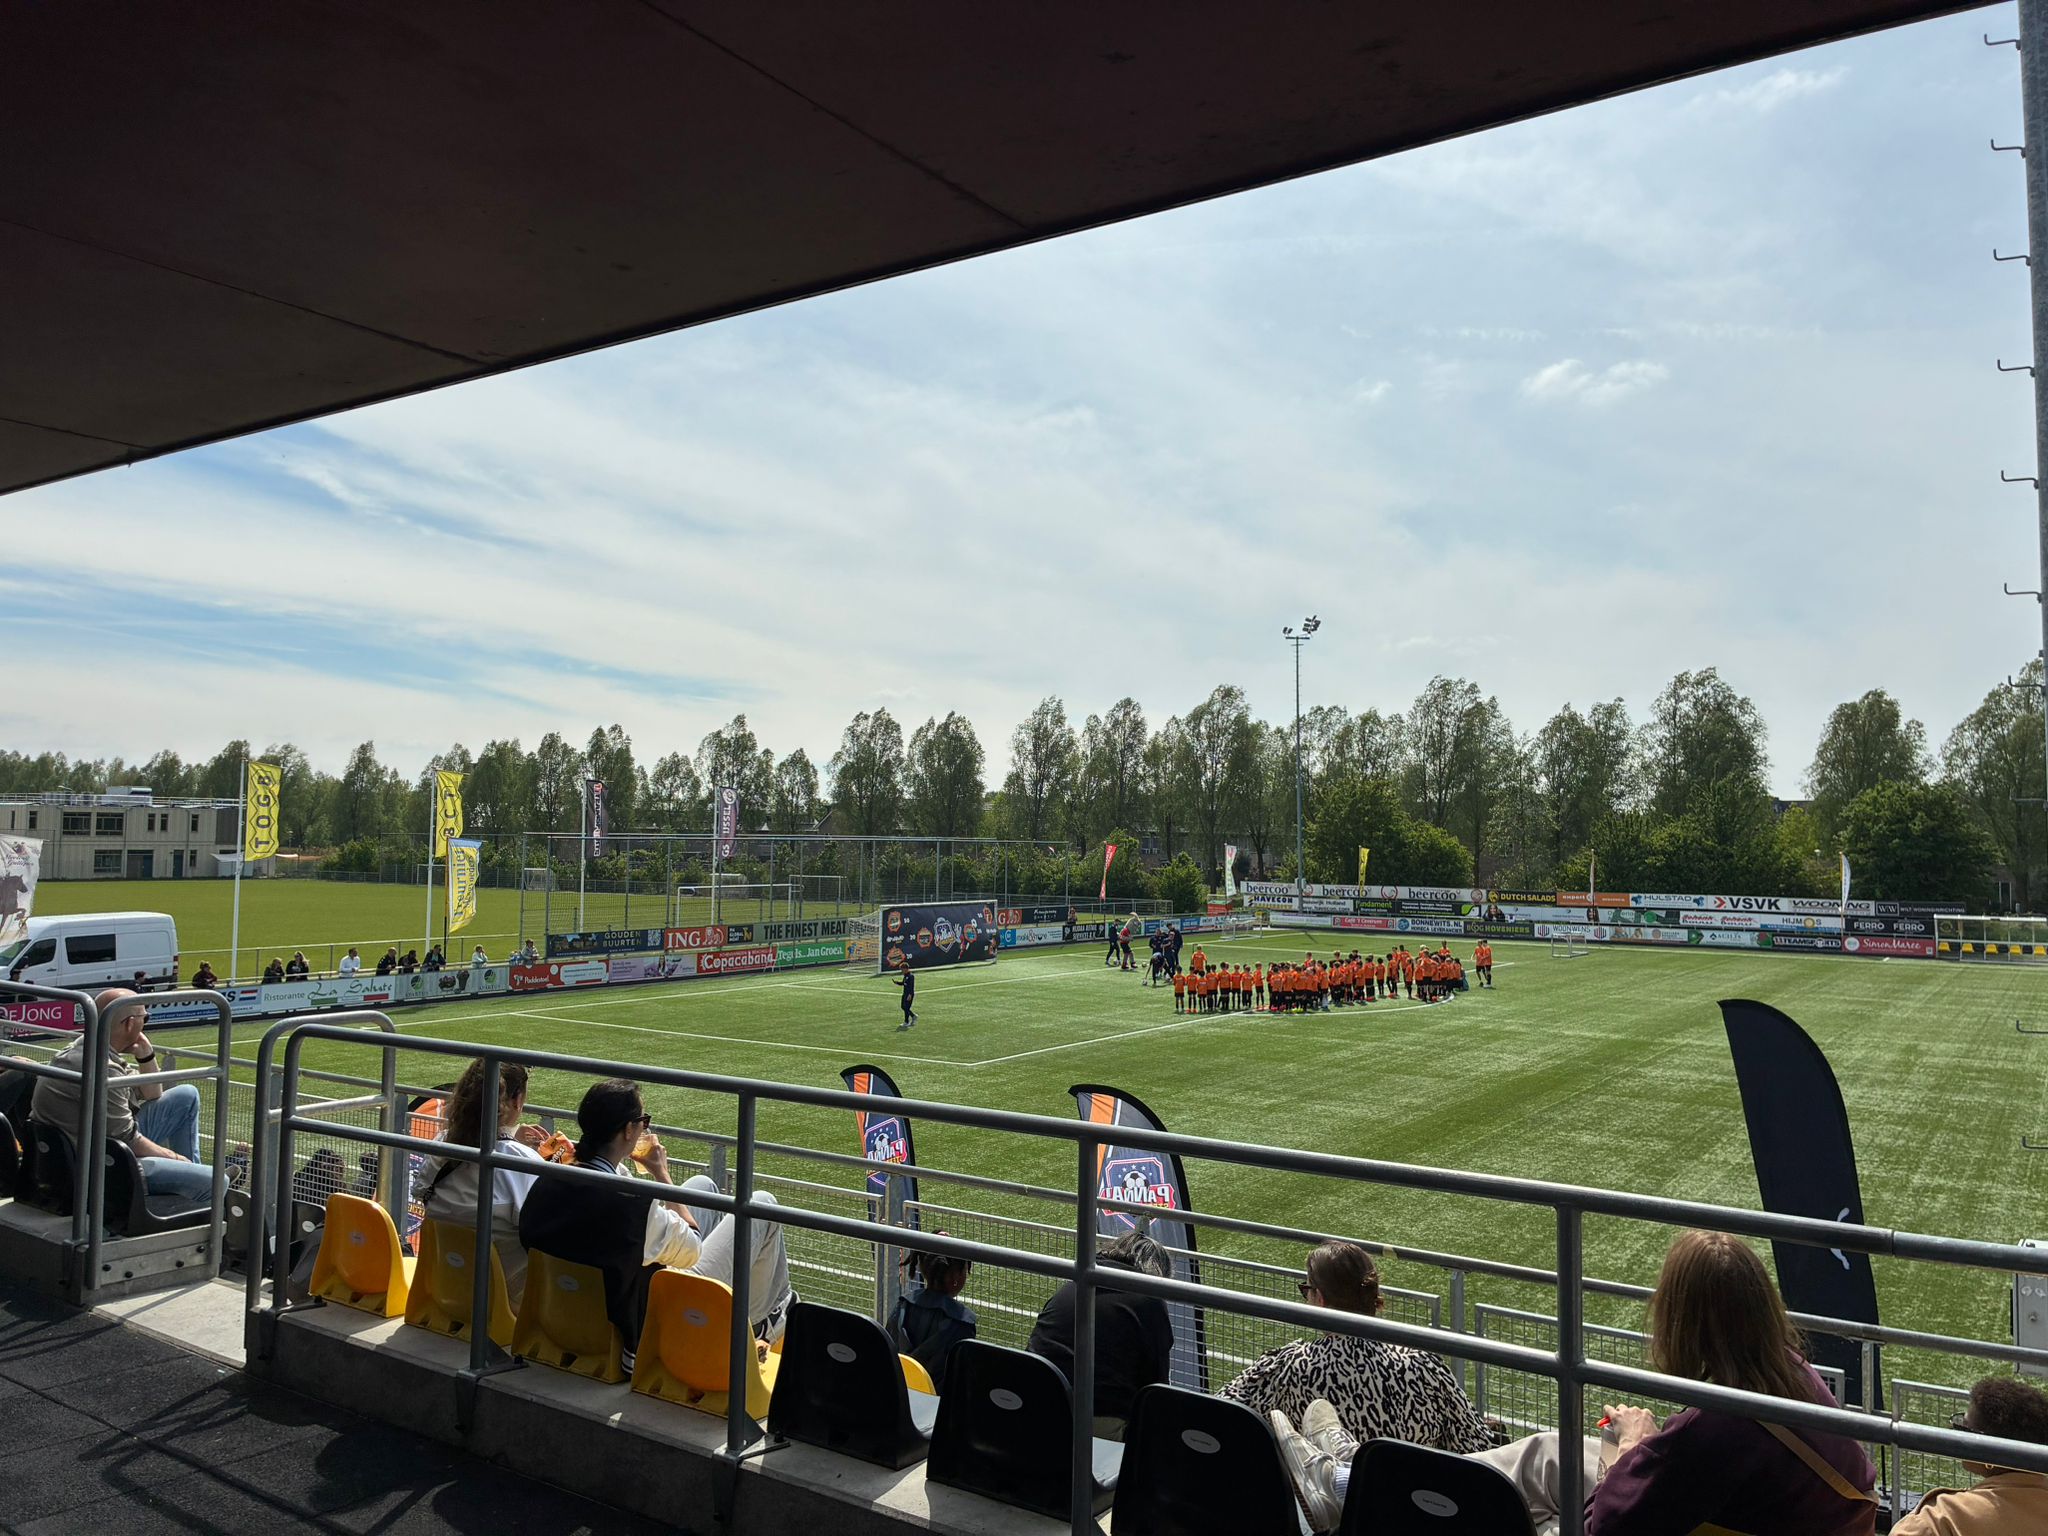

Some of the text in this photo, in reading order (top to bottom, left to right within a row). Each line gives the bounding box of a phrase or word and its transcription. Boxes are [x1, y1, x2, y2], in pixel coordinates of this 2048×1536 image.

[255, 775, 272, 849] TOGB
[1246, 883, 1289, 894] beercoo
[1408, 888, 1457, 900] beercoo
[1500, 893, 1556, 902] DUTCH SALADS
[1729, 897, 1781, 911] VSVK
[1792, 900, 1871, 908] WOONNG
[1410, 919, 1463, 927] BONNEWITS.NL
[1854, 922, 1885, 930] FERRO
[1893, 923, 1925, 931] FERRO
[604, 930, 641, 940] GOUDEN
[763, 920, 847, 940] THE FINEST MEAT
[602, 938, 641, 948] BUURTEN
[667, 931, 702, 948] ING
[704, 951, 773, 971] Copacabana
[264, 991, 305, 1002] Ristorante
